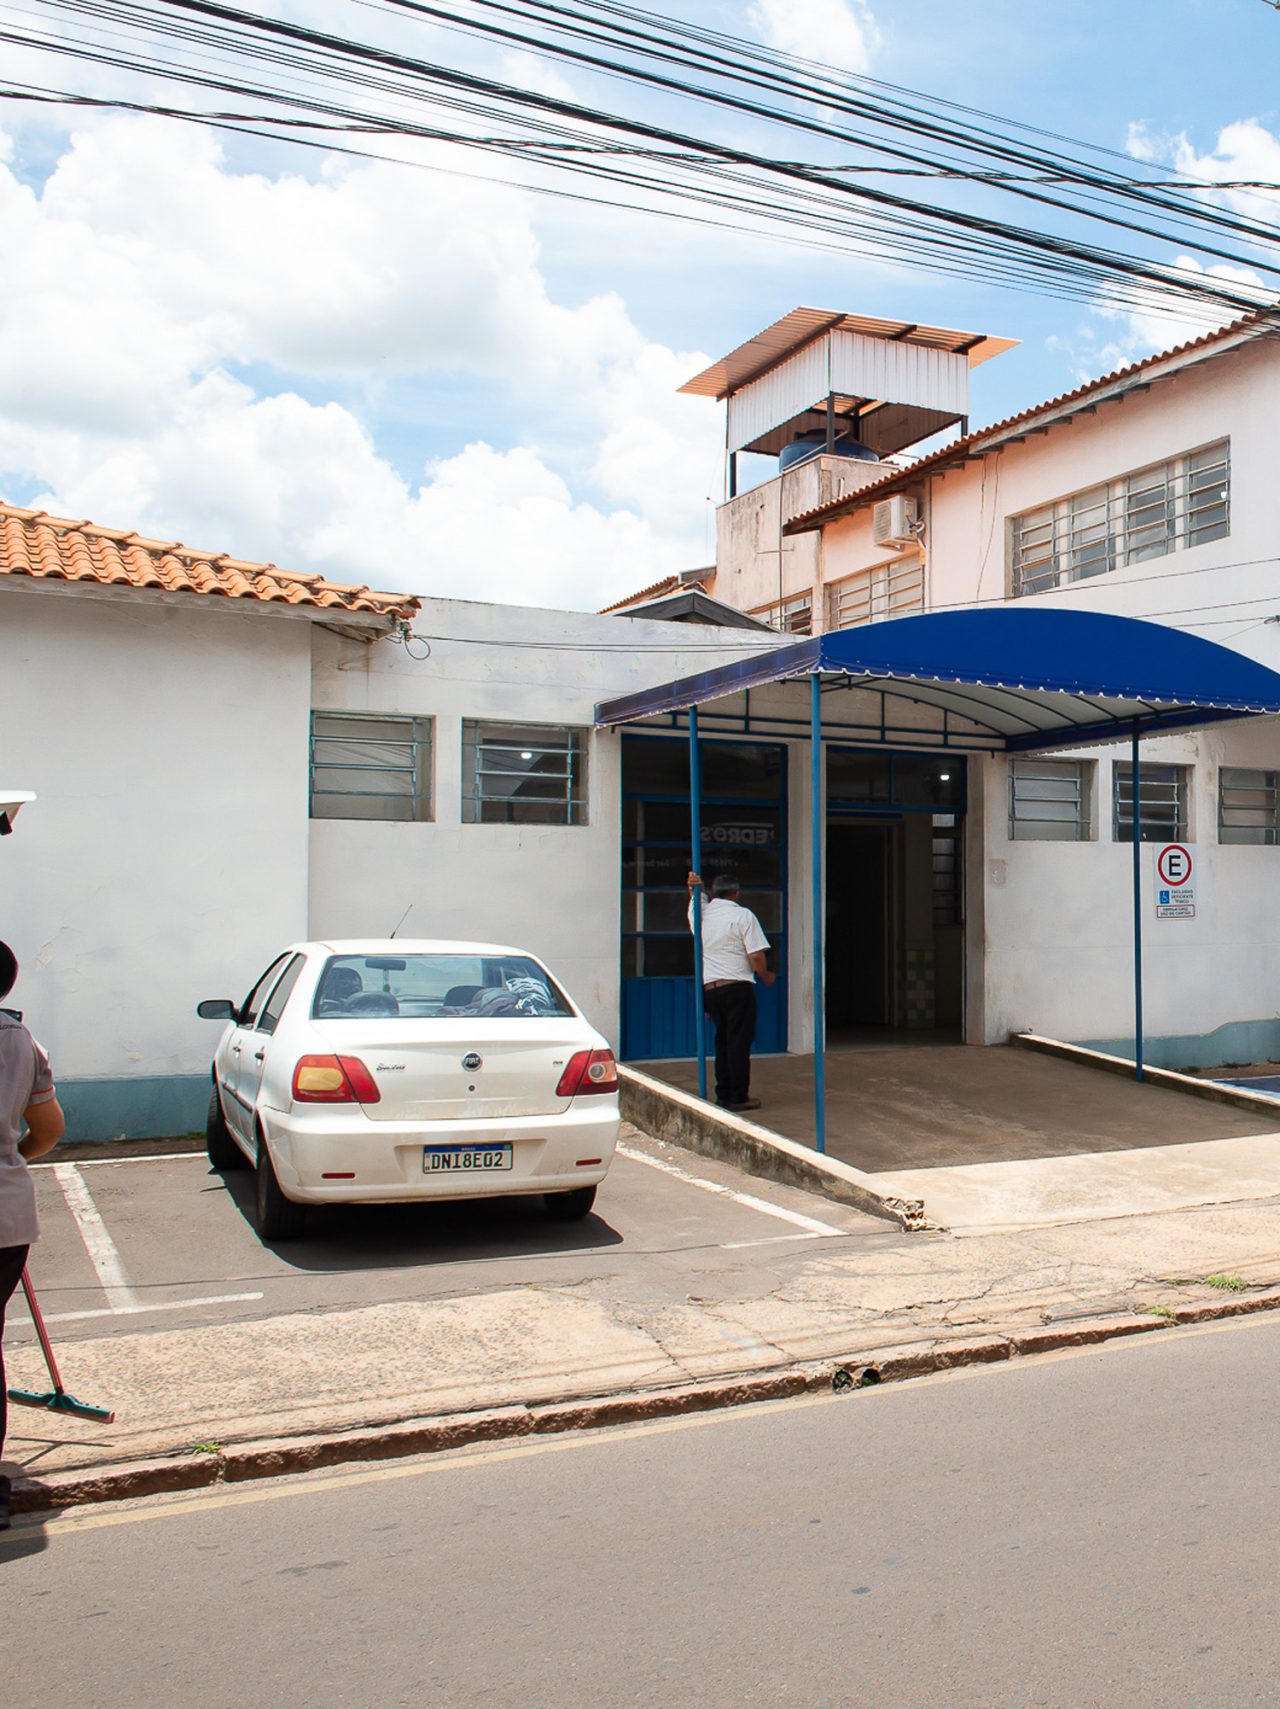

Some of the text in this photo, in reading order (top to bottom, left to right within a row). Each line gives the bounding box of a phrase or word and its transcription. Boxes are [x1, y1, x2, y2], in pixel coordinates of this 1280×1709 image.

[1169, 855, 1182, 876] E
[465, 1057, 480, 1065] FIAT
[430, 1151, 503, 1170] DNI8E02
